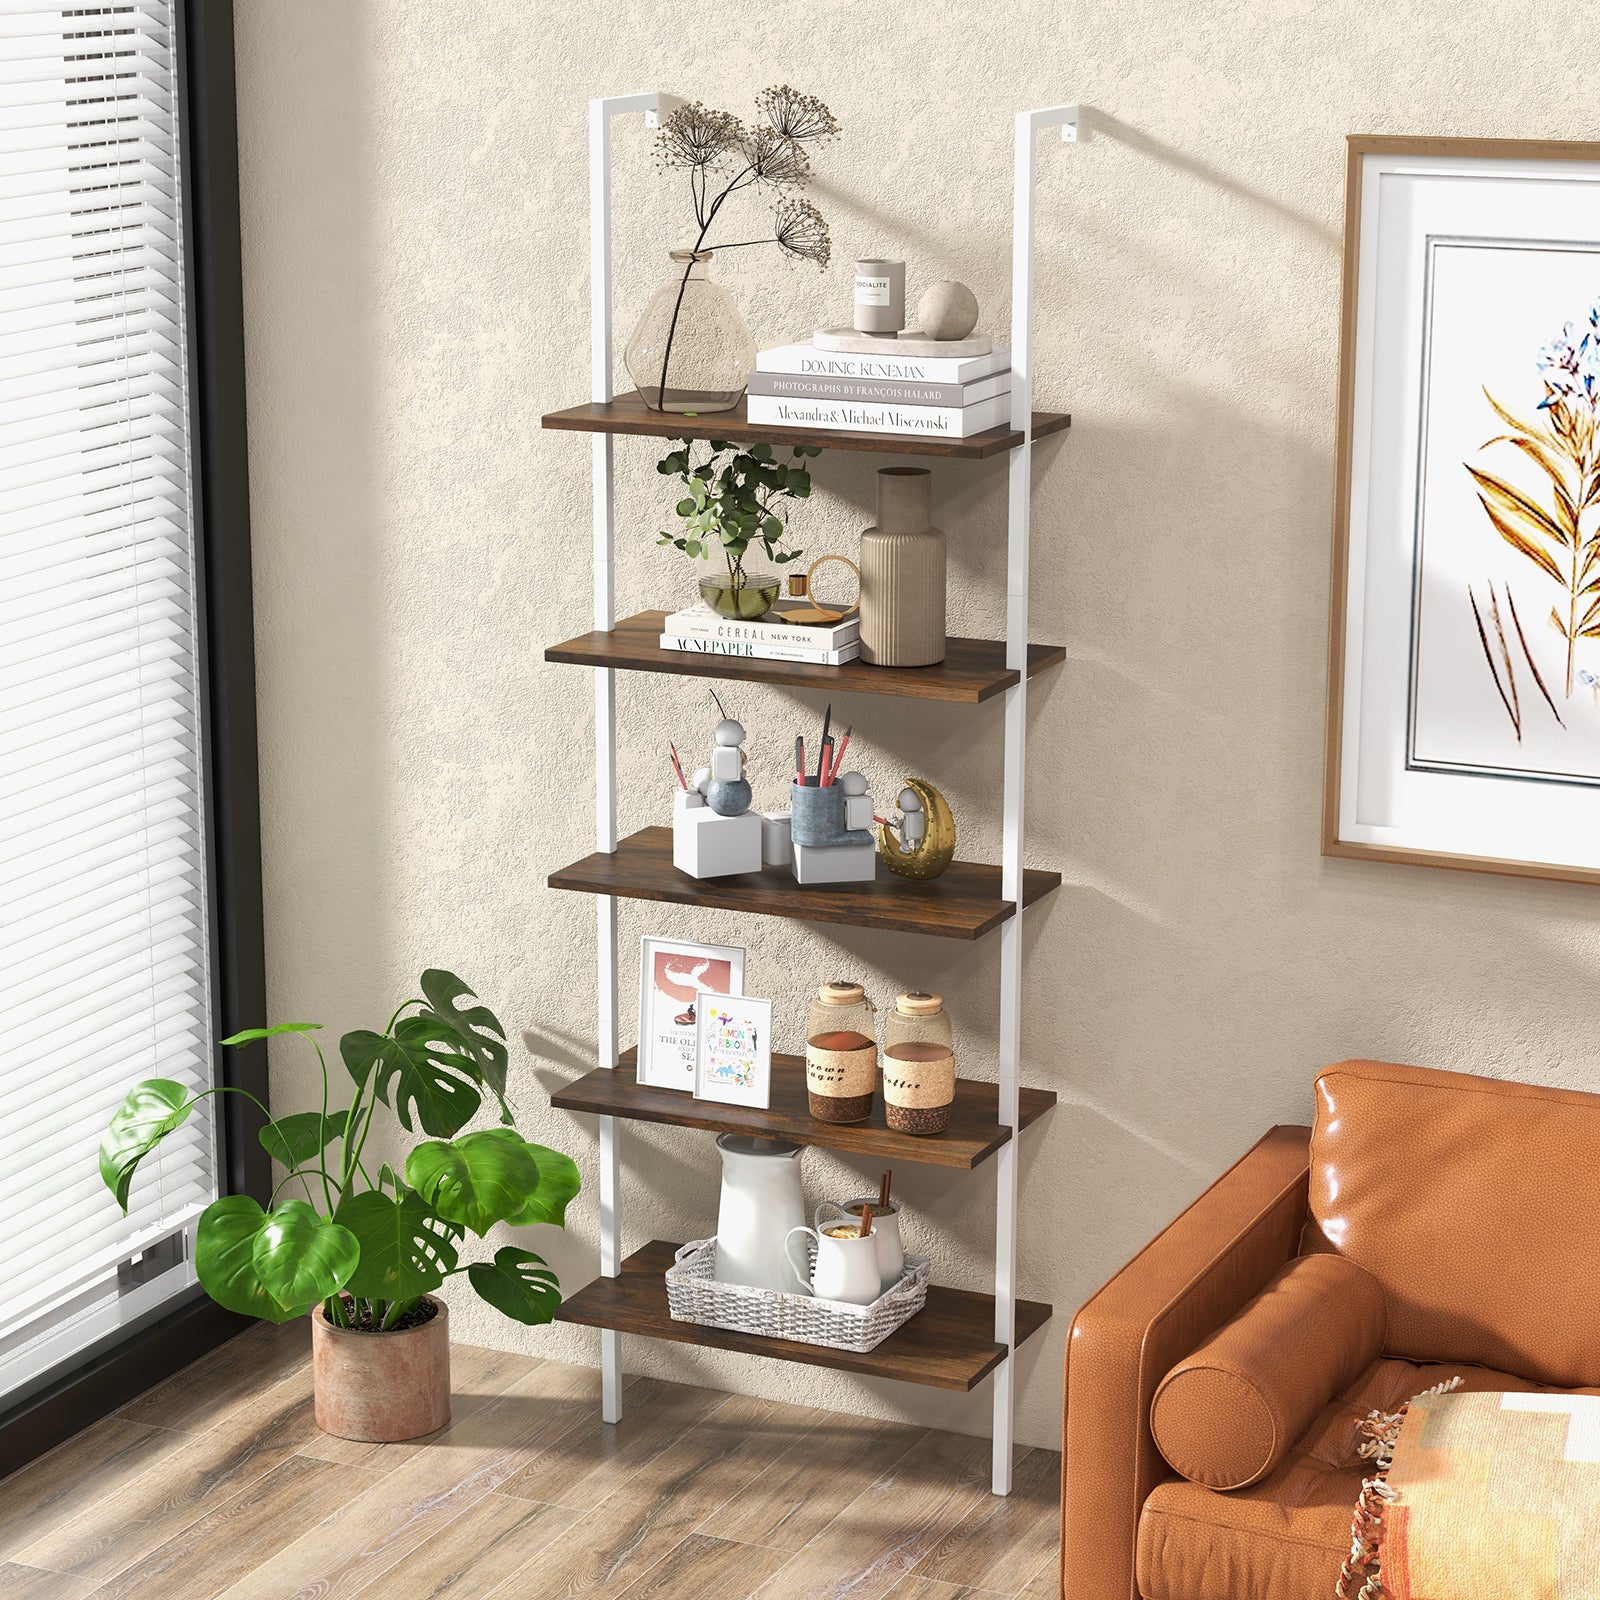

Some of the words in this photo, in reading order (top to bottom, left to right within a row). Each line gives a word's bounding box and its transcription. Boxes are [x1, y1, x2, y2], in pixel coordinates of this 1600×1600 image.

[801, 359, 856, 374] DOMINIC
[860, 362, 925, 378] KUNEMAN
[773, 381, 841, 392] PHOTOGRAPHS
[843, 385, 855, 394] BY
[856, 386, 902, 398] FRANÇOIS
[904, 389, 942, 400] HALARD
[718, 626, 765, 640] CEREAL
[771, 633, 788, 641] NEW
[720, 1028, 745, 1039] LEMON
[660, 1035, 678, 1045] THE
[719, 1038, 745, 1049] RIBBON
[681, 1052, 695, 1061] SE
[808, 1067, 844, 1081] ugar
